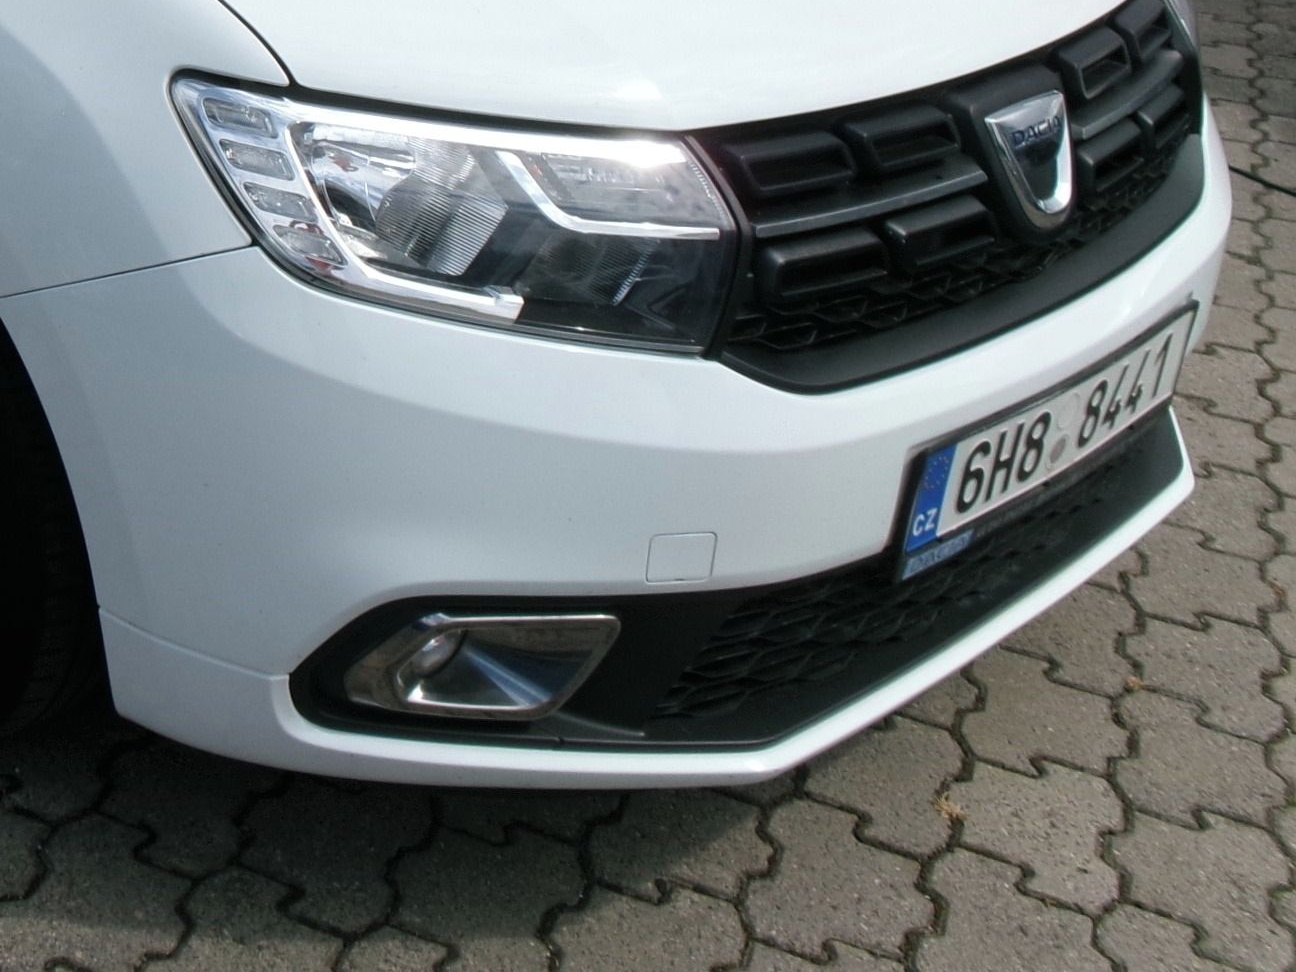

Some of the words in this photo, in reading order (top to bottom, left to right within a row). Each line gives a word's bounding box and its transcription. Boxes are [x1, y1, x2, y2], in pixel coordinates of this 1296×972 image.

[1012, 115, 1062, 146] DACIA
[956, 411, 1052, 515] 6H8
[1078, 331, 1174, 449] 8441
[912, 507, 938, 537] CZ
